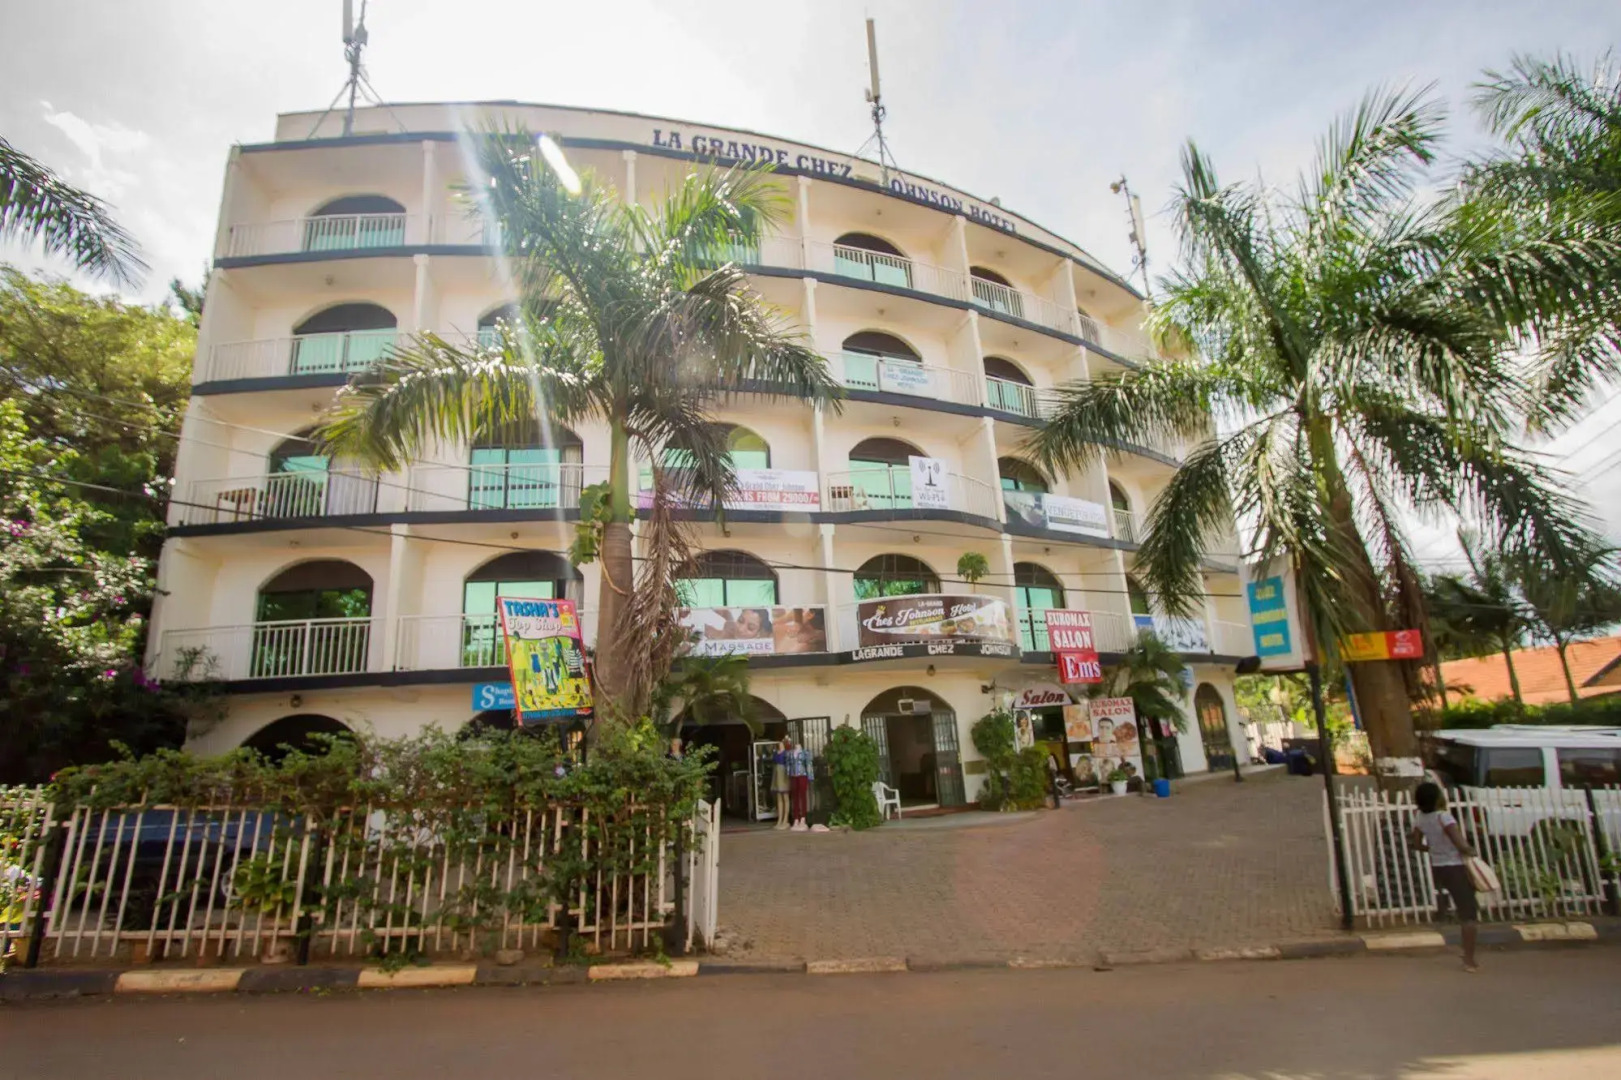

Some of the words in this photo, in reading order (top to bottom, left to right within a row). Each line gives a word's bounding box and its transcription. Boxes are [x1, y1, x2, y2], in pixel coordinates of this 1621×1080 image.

[652, 129, 682, 149] LA
[691, 135, 789, 166] GRANDE
[796, 154, 854, 178] CHEZ
[504, 600, 560, 618] TASHA'S
[895, 608, 945, 626] Johnson
[1046, 612, 1091, 627] EUROMAX
[1053, 630, 1092, 649] SALON
[852, 646, 904, 661] LAGRANDE
[927, 644, 955, 655] CHEZ
[1063, 655, 1101, 679] Ems
[1021, 689, 1065, 705] Salon
[1090, 698, 1133, 709] EUROMAX
[1092, 707, 1131, 717] SALON
